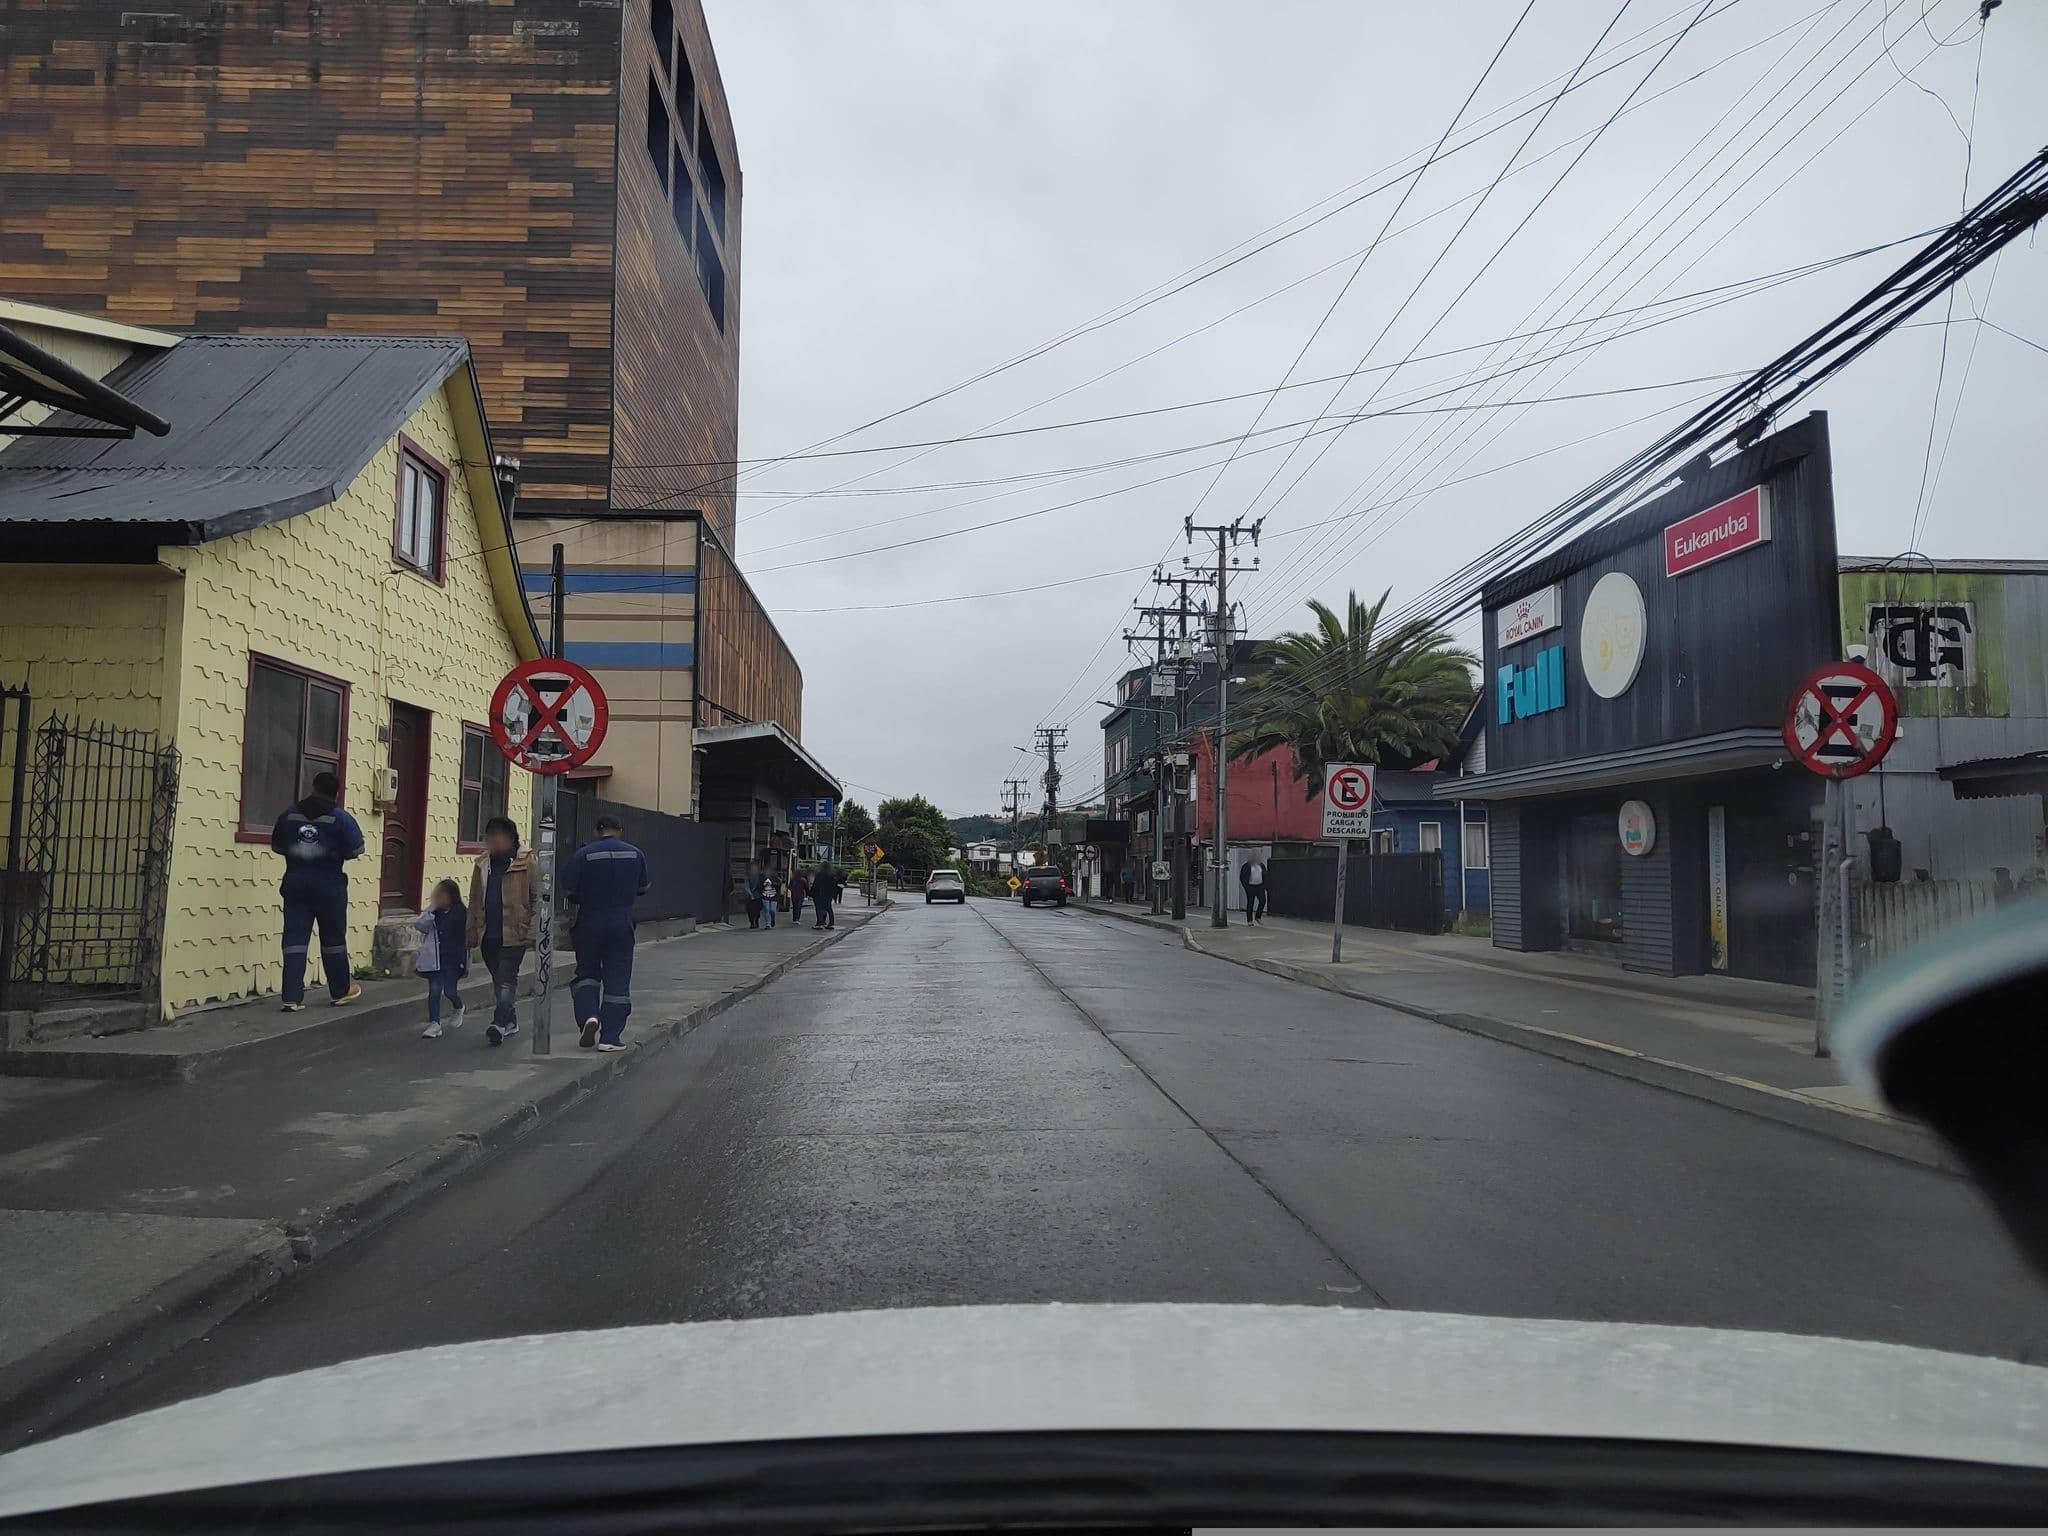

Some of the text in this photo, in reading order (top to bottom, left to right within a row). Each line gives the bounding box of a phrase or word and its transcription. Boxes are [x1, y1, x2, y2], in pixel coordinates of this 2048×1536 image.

[1674, 514, 1748, 559] Eukanuba
[1505, 614, 1544, 641] ROYAL CANIN
[1498, 645, 1565, 724] Full
[1341, 777, 1359, 803] E
[815, 799, 827, 817] E
[1326, 810, 1369, 819] PROHIBIDO
[1326, 827, 1367, 835] DESCARGA
[1330, 819, 1355, 827] CARGA
